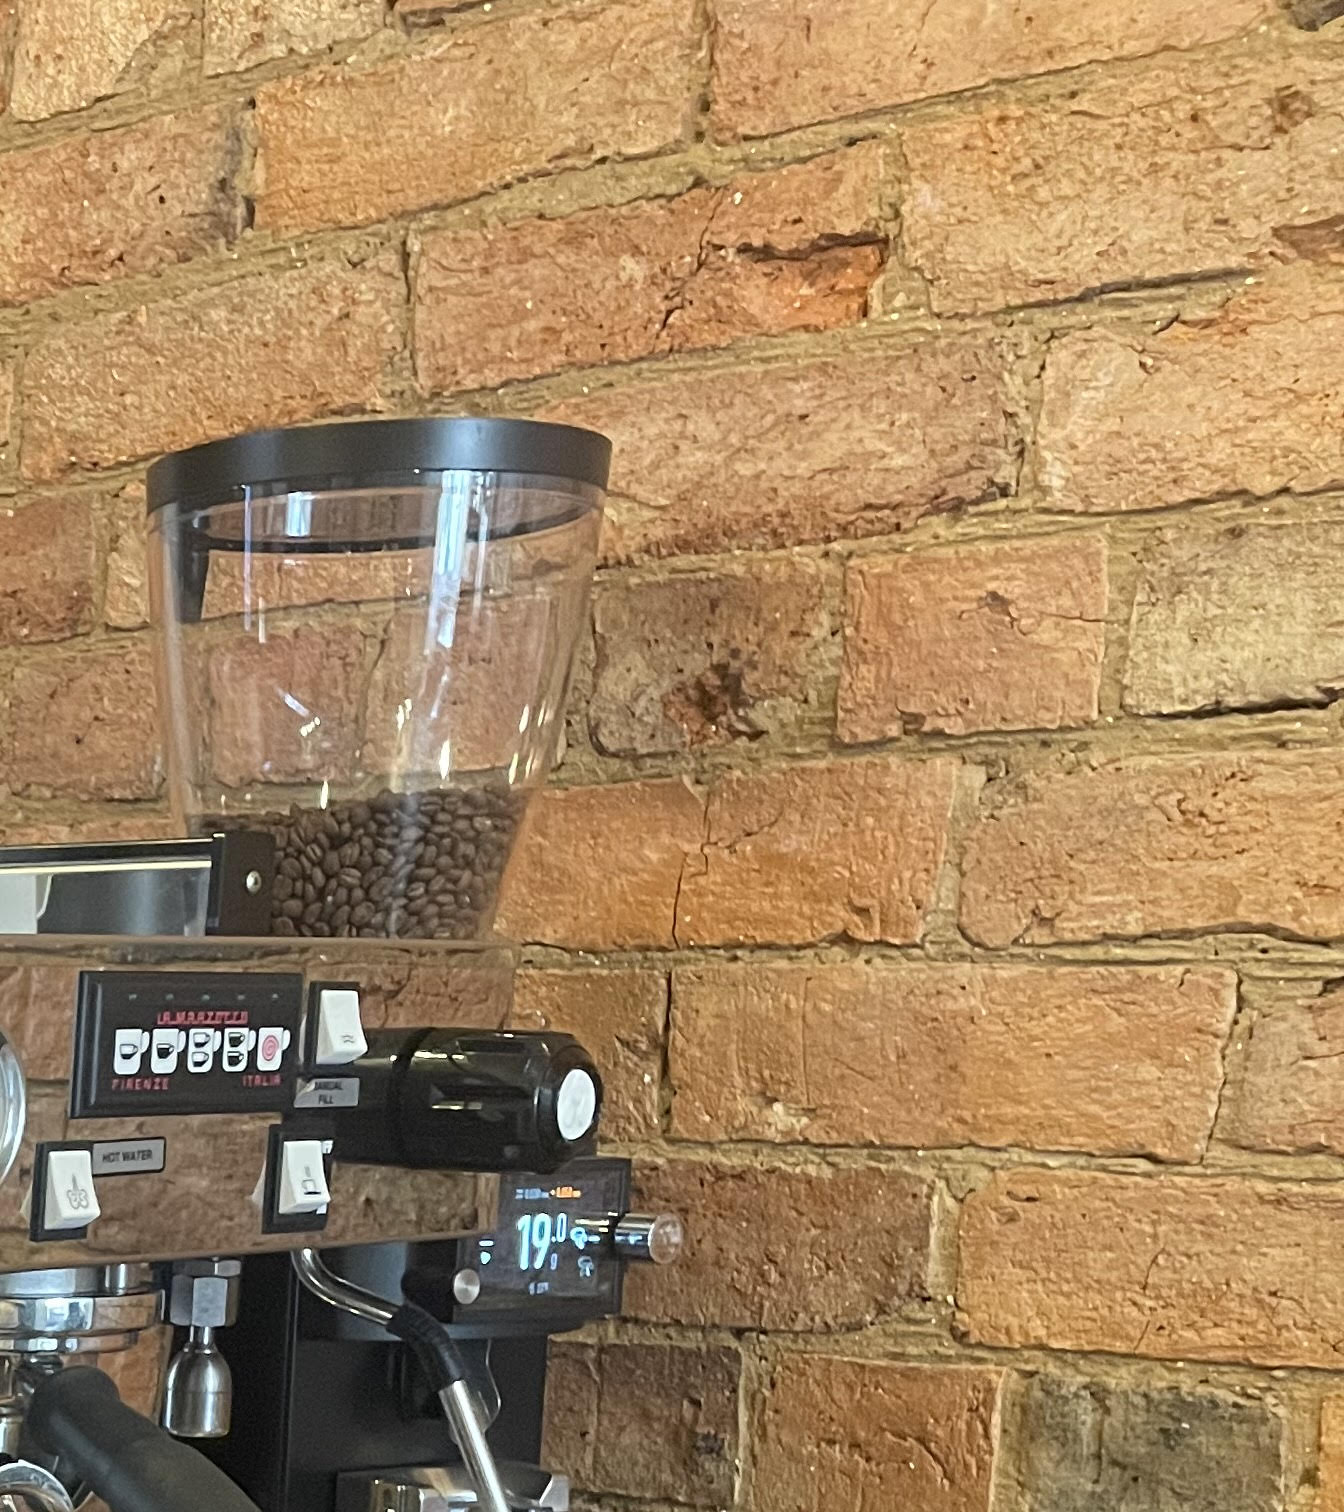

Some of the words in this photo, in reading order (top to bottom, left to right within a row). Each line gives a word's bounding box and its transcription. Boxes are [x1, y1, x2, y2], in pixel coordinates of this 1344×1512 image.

[112, 1077, 169, 1090] FIRENZE
[242, 1074, 281, 1087] ITALIA
[122, 1149, 153, 1161] WATER
